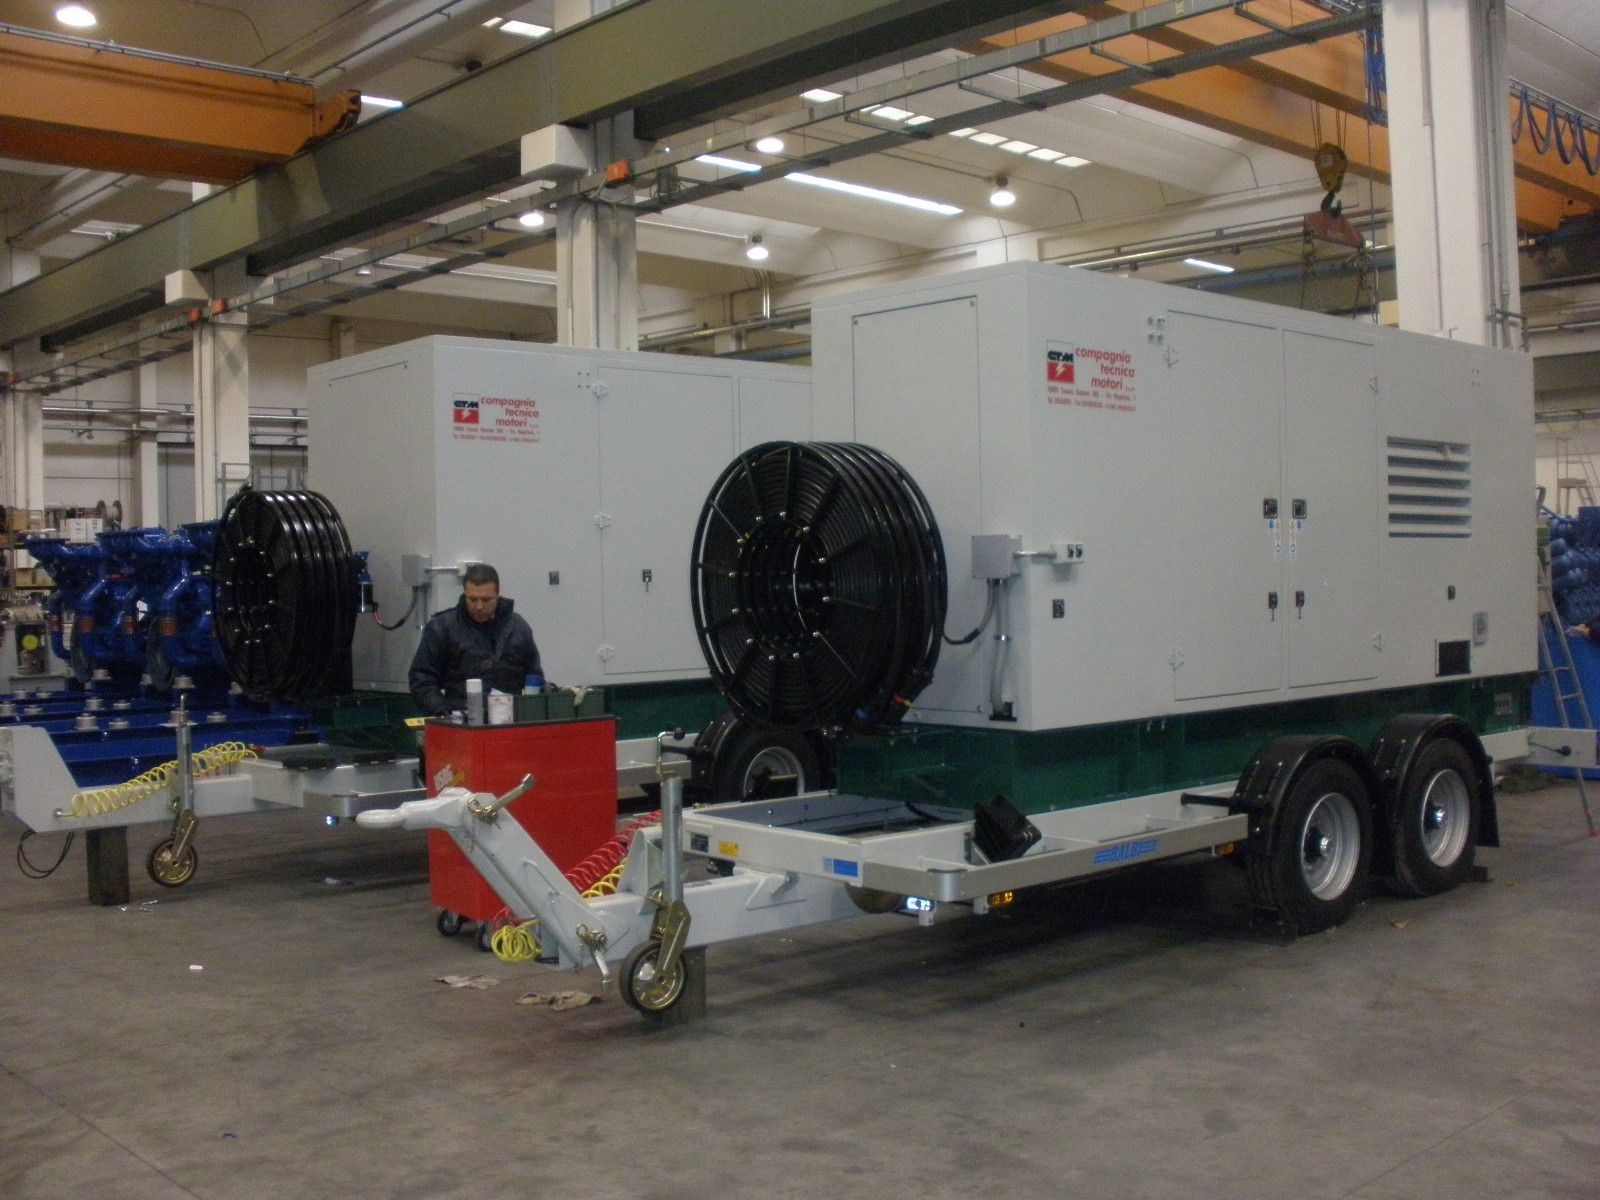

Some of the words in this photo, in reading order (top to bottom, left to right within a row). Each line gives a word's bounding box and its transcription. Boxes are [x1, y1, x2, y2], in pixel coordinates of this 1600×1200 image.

[1047, 351, 1074, 363] CTM
[1075, 347, 1131, 364] compagnia
[1101, 364, 1136, 378] tecnica
[1091, 377, 1123, 390] motori
[480, 396, 536, 408] compagnia
[505, 408, 540, 418] tecnica
[496, 418, 526, 427] motori
